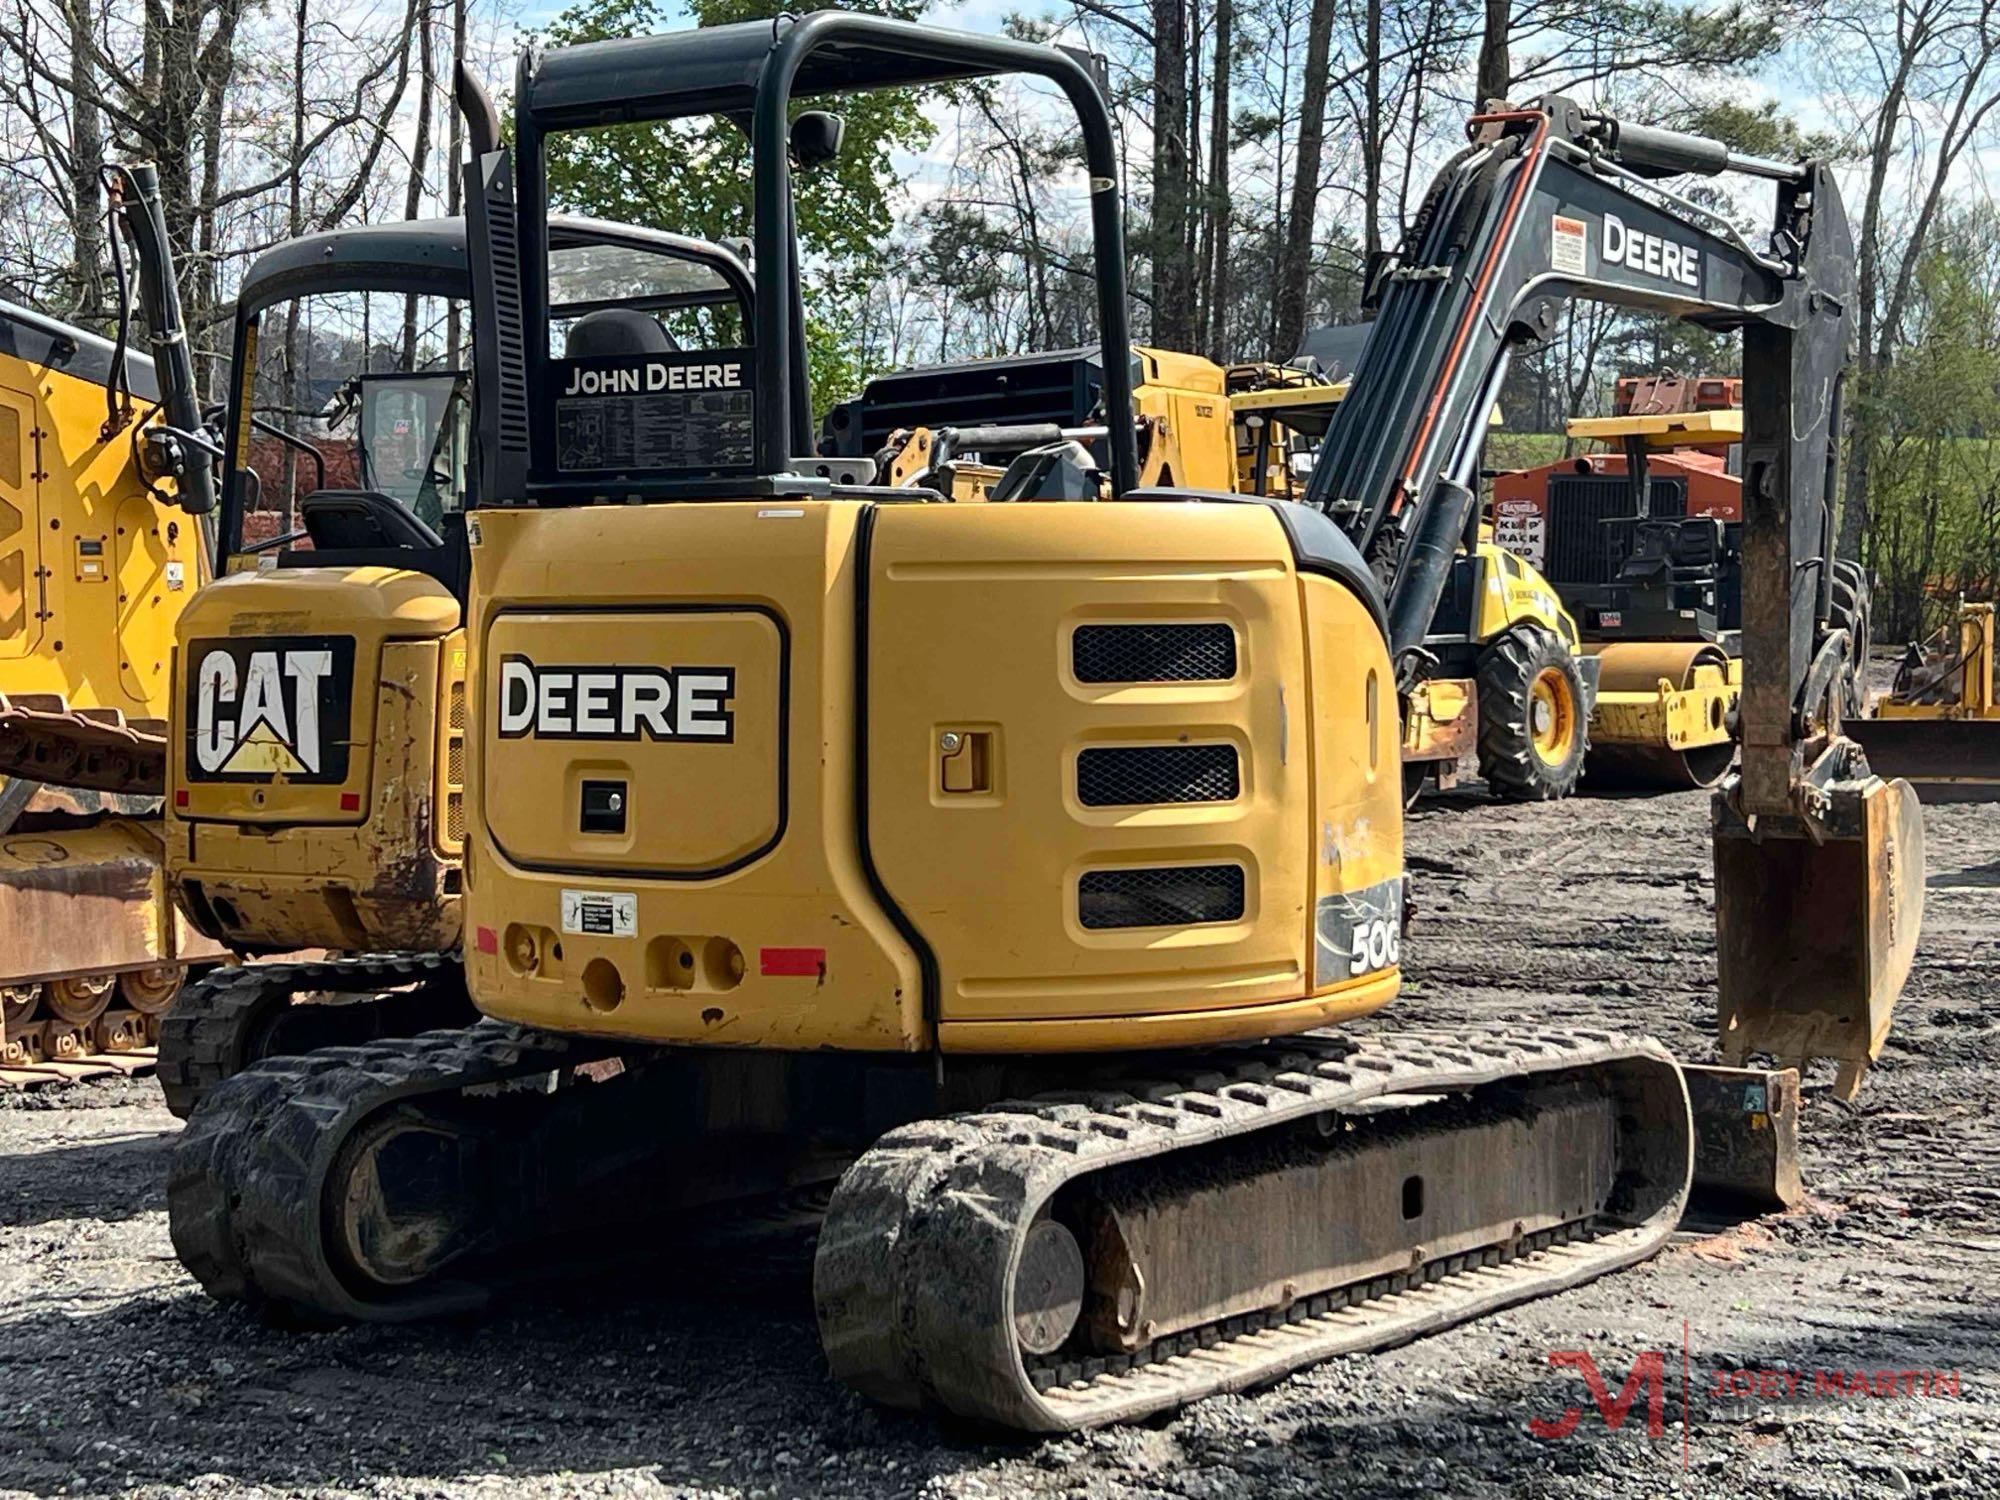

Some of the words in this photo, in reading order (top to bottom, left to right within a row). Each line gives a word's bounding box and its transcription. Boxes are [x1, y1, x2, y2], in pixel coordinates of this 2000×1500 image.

[1602, 212, 1699, 287] DEERE
[565, 367, 639, 395] JOHN
[646, 363, 741, 391] DEERE
[1498, 534, 1538, 543] BACK
[1500, 520, 1538, 529] KEP
[197, 650, 332, 774] CAT
[501, 661, 728, 736] DEERE
